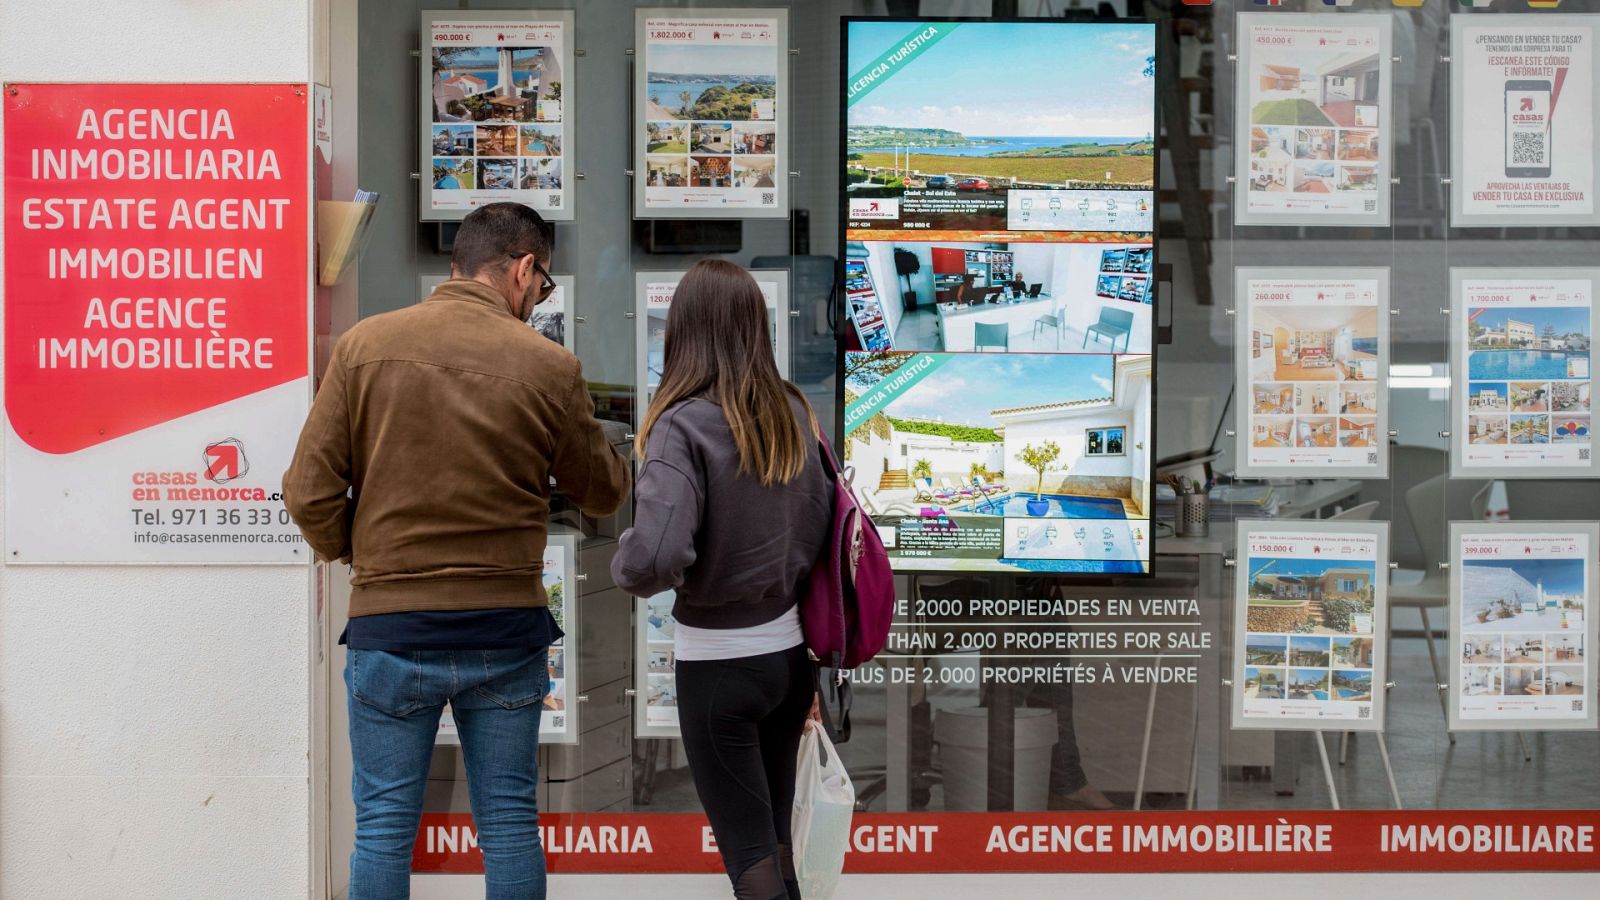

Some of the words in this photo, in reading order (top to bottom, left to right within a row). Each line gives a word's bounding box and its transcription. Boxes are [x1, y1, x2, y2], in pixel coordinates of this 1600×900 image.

[433, 33, 465, 41] 490.000
[650, 31, 686, 39] 1.802.000
[687, 31, 693, 39] €
[1256, 36, 1286, 44] 450.000
[1476, 35, 1514, 44] ¿PENSANDO
[1515, 35, 1524, 43] EN
[1525, 35, 1550, 43] VENDER
[1552, 35, 1560, 43] TU
[1561, 35, 1582, 43] CASA?
[1485, 45, 1511, 53] TENEMOS
[1512, 45, 1522, 53] UNA
[1524, 45, 1551, 53] SORPRESA
[1552, 45, 1566, 53] PARA
[1567, 45, 1573, 53] TI
[847, 61, 890, 99] LICENCIA
[887, 26, 938, 66] TURÍSTICA
[1525, 56, 1542, 65] ESTE
[1544, 53, 1570, 65] CÓDIGO
[1504, 67, 1509, 76] E
[77, 108, 235, 141] AGENCIA
[31, 148, 282, 180] INMOBILIARIA
[1487, 182, 1520, 191] APROVECHA
[1521, 182, 1533, 191] LAS
[1533, 182, 1562, 191] VENTAJAS
[1562, 182, 1570, 191] DE
[1473, 191, 1500, 201] VENDER
[1503, 191, 1513, 201] TU
[1513, 191, 1532, 201] CASA
[1534, 191, 1544, 201] EN
[1545, 191, 1584, 201] EXCLUSIVA
[22, 198, 157, 230] ESTATE
[168, 198, 291, 230] AGENT
[48, 248, 263, 280] IMMOBILIEN
[649, 295, 673, 303] 120.00
[84, 297, 227, 329] AGENCE
[39, 331, 274, 369] IMMOBILIÈRE
[845, 390, 888, 426] LICENCIA
[883, 355, 935, 394] TURÍSTICA
[132, 471, 198, 486] casas
[132, 487, 160, 501] en
[167, 487, 284, 501] menorca.c
[132, 508, 165, 526] Tel.
[171, 508, 207, 526] 971
[216, 508, 241, 526] 36
[248, 508, 271, 526] 33
[133, 531, 304, 545] info@casasenmenorca.com
[915, 599, 962, 616] 2000
[969, 599, 1100, 617] PROPIEDADES
[1107, 599, 1132, 616] EN
[1140, 599, 1201, 616] VENTA
[888, 632, 936, 649] THAN
[943, 632, 997, 649] 2.000
[1003, 632, 1117, 649] PROPERTIES
[1124, 632, 1160, 649] FOR
[1168, 632, 1212, 649] SALE
[838, 667, 884, 684] PLUS
[891, 667, 916, 684] DE
[922, 667, 976, 684] 2.000
[983, 662, 1096, 684] PROPRIÉTÉS
[1102, 662, 1115, 684] À
[1121, 667, 1198, 684] VENDRE
[427, 825, 653, 853] INMILIARIA
[985, 825, 1113, 853] AGENCE
[1122, 818, 1333, 853] IMMOBILIÈRE
[1380, 825, 1594, 853] IMMOBILIARE
